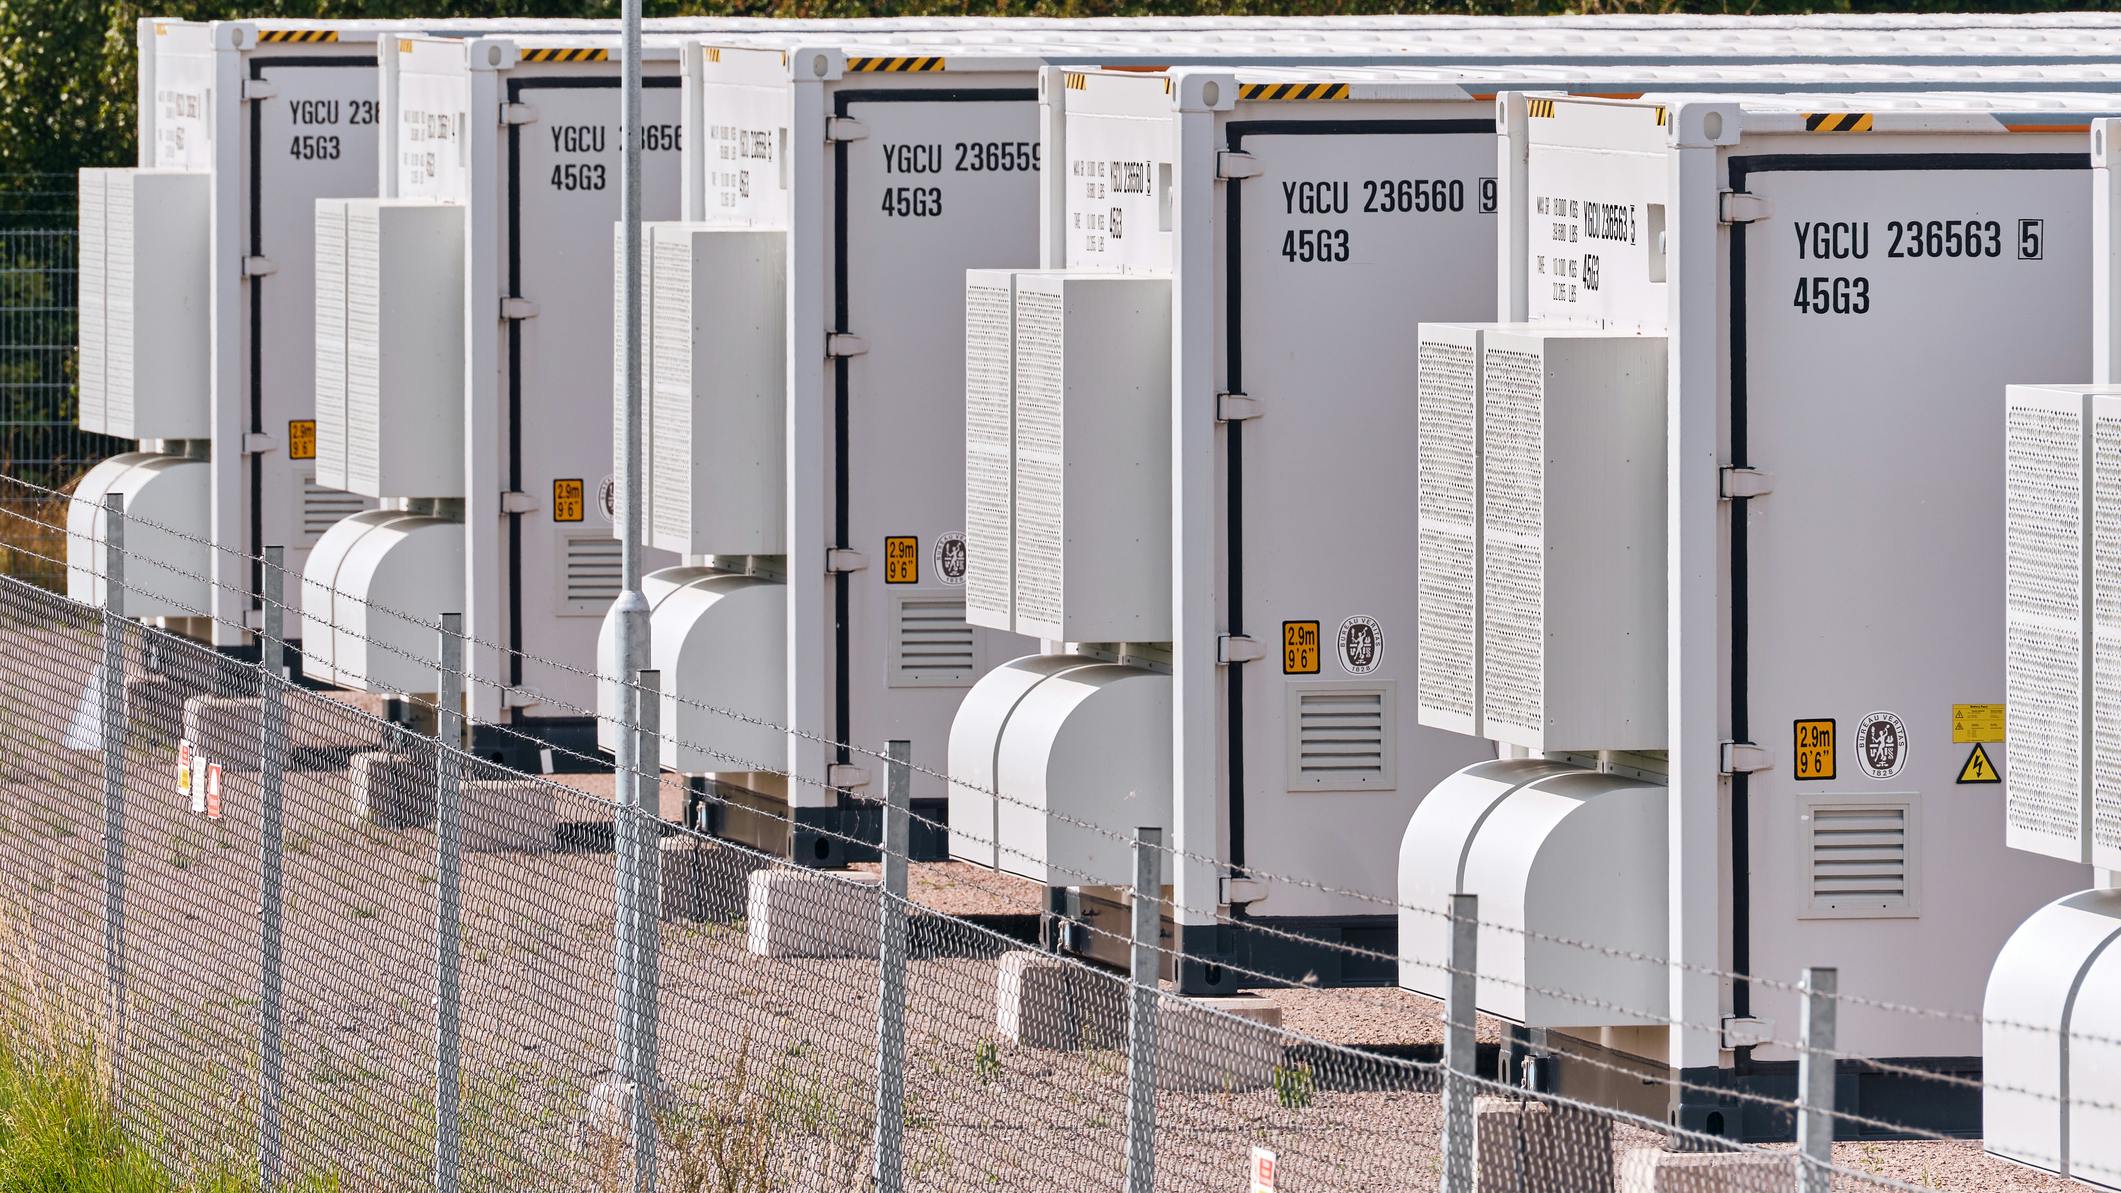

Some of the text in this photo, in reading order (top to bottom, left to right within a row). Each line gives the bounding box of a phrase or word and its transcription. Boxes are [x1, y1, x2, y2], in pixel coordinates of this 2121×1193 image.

[290, 100, 338, 124] YGCU
[290, 136, 340, 160] 45G3
[552, 126, 604, 152] YGCU
[882, 144, 942, 174] YGCU
[955, 142, 1040, 172] 236559
[551, 164, 606, 190] 45G3
[882, 187, 942, 217] 45G3
[1282, 179, 1498, 214] YGCU 236560 9
[1584, 201, 1636, 244] YGCU 236563 5
[1282, 230, 1350, 262] 45G3
[1794, 220, 2040, 259] YGCU 236563 5
[1582, 254, 1600, 292] 45G3
[1794, 276, 1870, 314] 45G3
[890, 541, 914, 558] 2.9m
[1288, 626, 1315, 646] 2.9m
[1340, 618, 1380, 648] BUREAU VERITAS
[1800, 726, 1830, 748] 2.9m
[1859, 714, 1904, 748] BUREAU VERITAS
[1872, 768, 1894, 776] 1828
